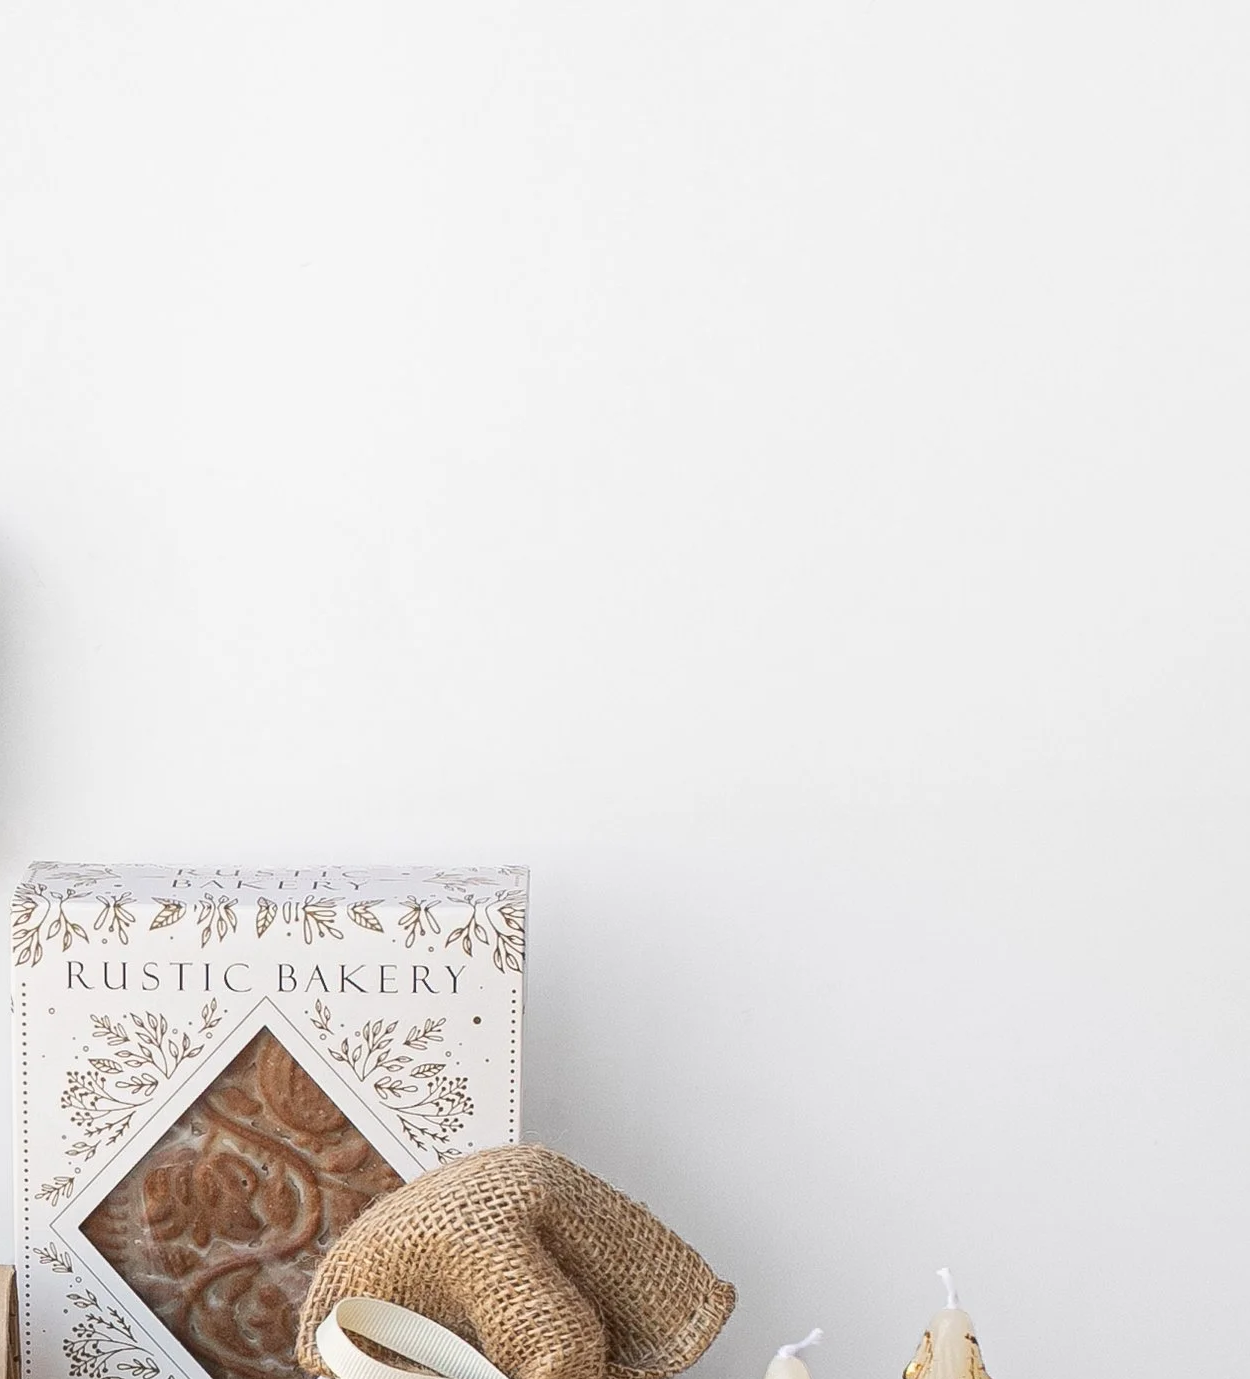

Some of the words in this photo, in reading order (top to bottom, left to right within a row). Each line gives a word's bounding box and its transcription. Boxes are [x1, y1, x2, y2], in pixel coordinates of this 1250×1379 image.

[177, 868, 371, 877] RUSTIC
[172, 879, 369, 891] BAKERY
[66, 960, 253, 993] RUSTIC
[276, 963, 468, 995] BAKERY
